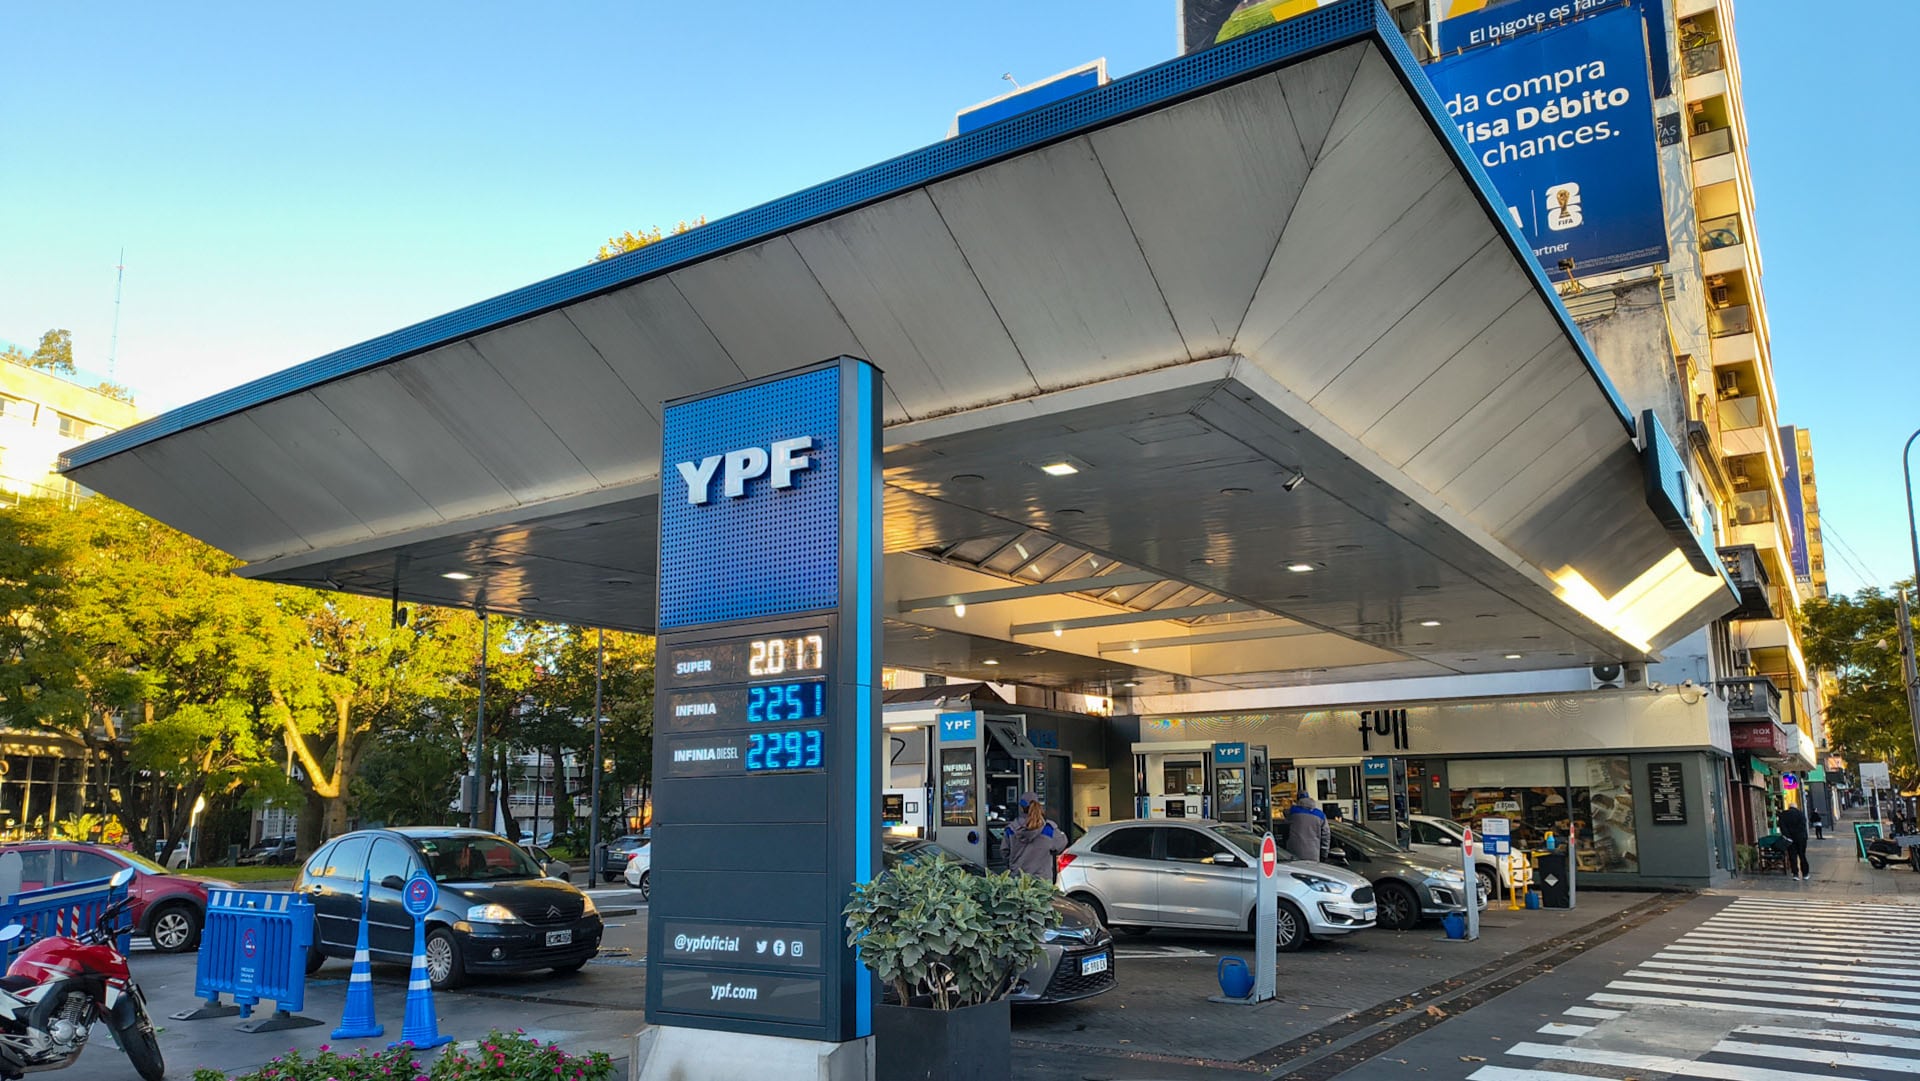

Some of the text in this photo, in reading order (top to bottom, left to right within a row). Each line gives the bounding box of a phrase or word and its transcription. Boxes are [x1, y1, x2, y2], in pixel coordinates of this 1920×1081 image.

[1470, 30, 1485, 44] El
[1489, 11, 1545, 40] bigote
[1549, 4, 1570, 18] es
[1486, 60, 1605, 107] compra
[1516, 87, 1630, 131] Débito
[1482, 120, 1621, 167] chances.
[1558, 218, 1574, 226] FIFA
[675, 435, 812, 504] YPF
[676, 634, 823, 676] SUPER 2.017
[675, 684, 822, 722] INFINIA 2251
[945, 720, 971, 730] YPF
[674, 730, 821, 769] INFINIA DIESEL 2293
[1219, 748, 1241, 756] YPF
[674, 933, 739, 953] @ypfoficial
[711, 983, 757, 1001] ypf.com
